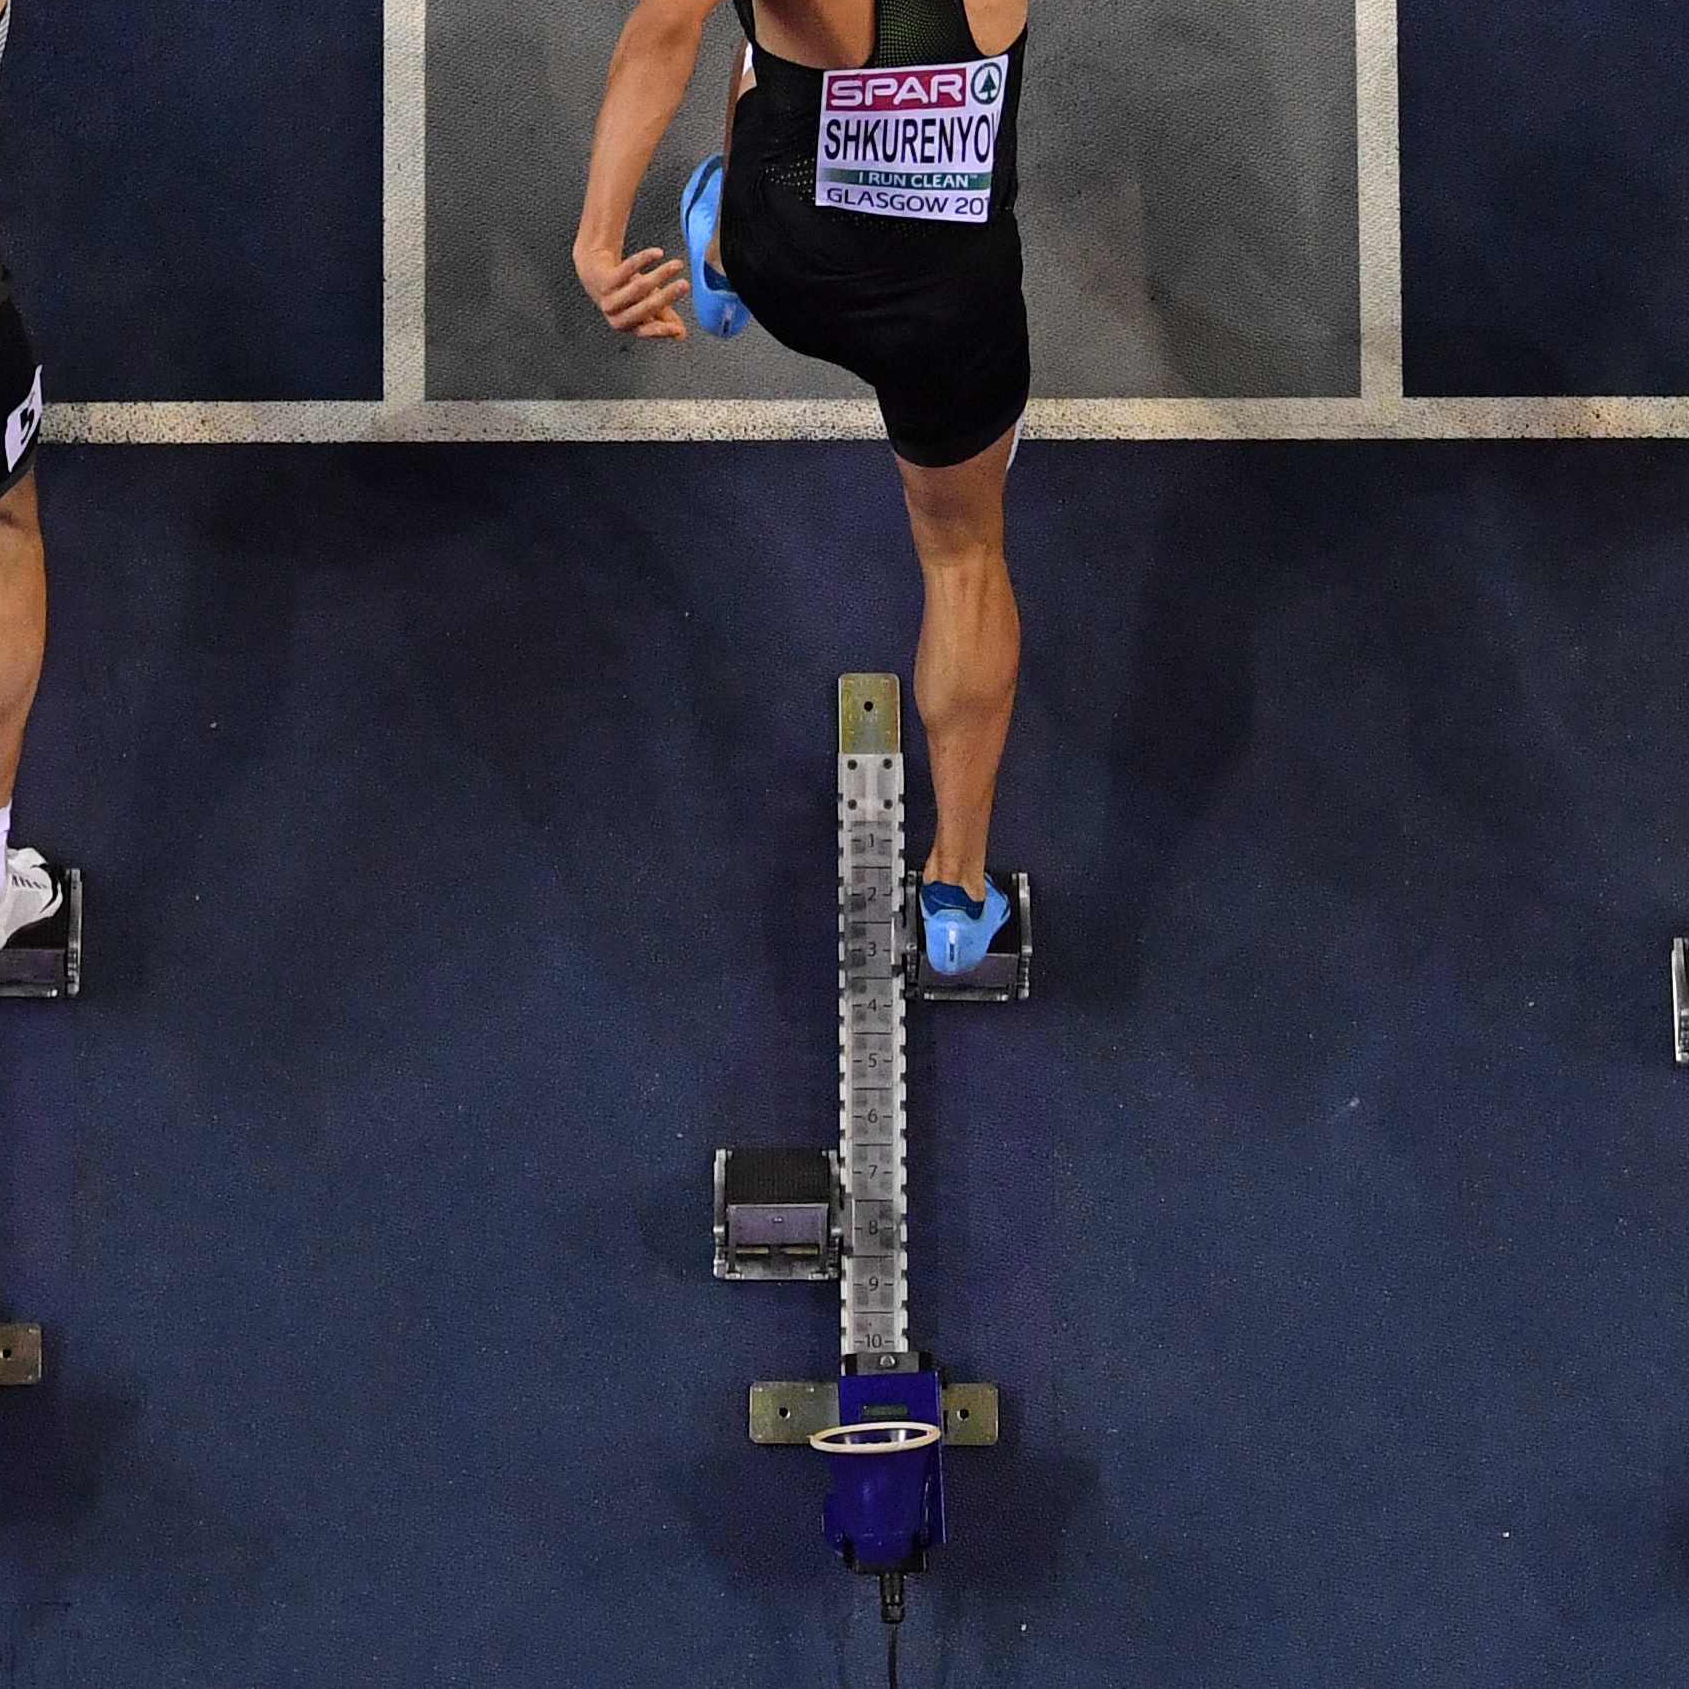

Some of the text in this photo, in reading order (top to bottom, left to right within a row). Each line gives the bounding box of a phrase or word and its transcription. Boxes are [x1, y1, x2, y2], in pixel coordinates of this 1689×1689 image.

[830, 74, 962, 107] SPAR
[868, 172, 906, 187] RUN
[826, 188, 949, 213] GLASGOW
[867, 886, 877, 902] 2
[867, 941, 877, 957] 3
[866, 997, 878, 1012] 4
[867, 1053, 878, 1068] 5
[867, 1108, 878, 1123] 6
[867, 1164, 878, 1180] 7
[868, 1220, 879, 1235] 8
[868, 1276, 879, 1292] 9
[864, 1333, 882, 1350] 10
